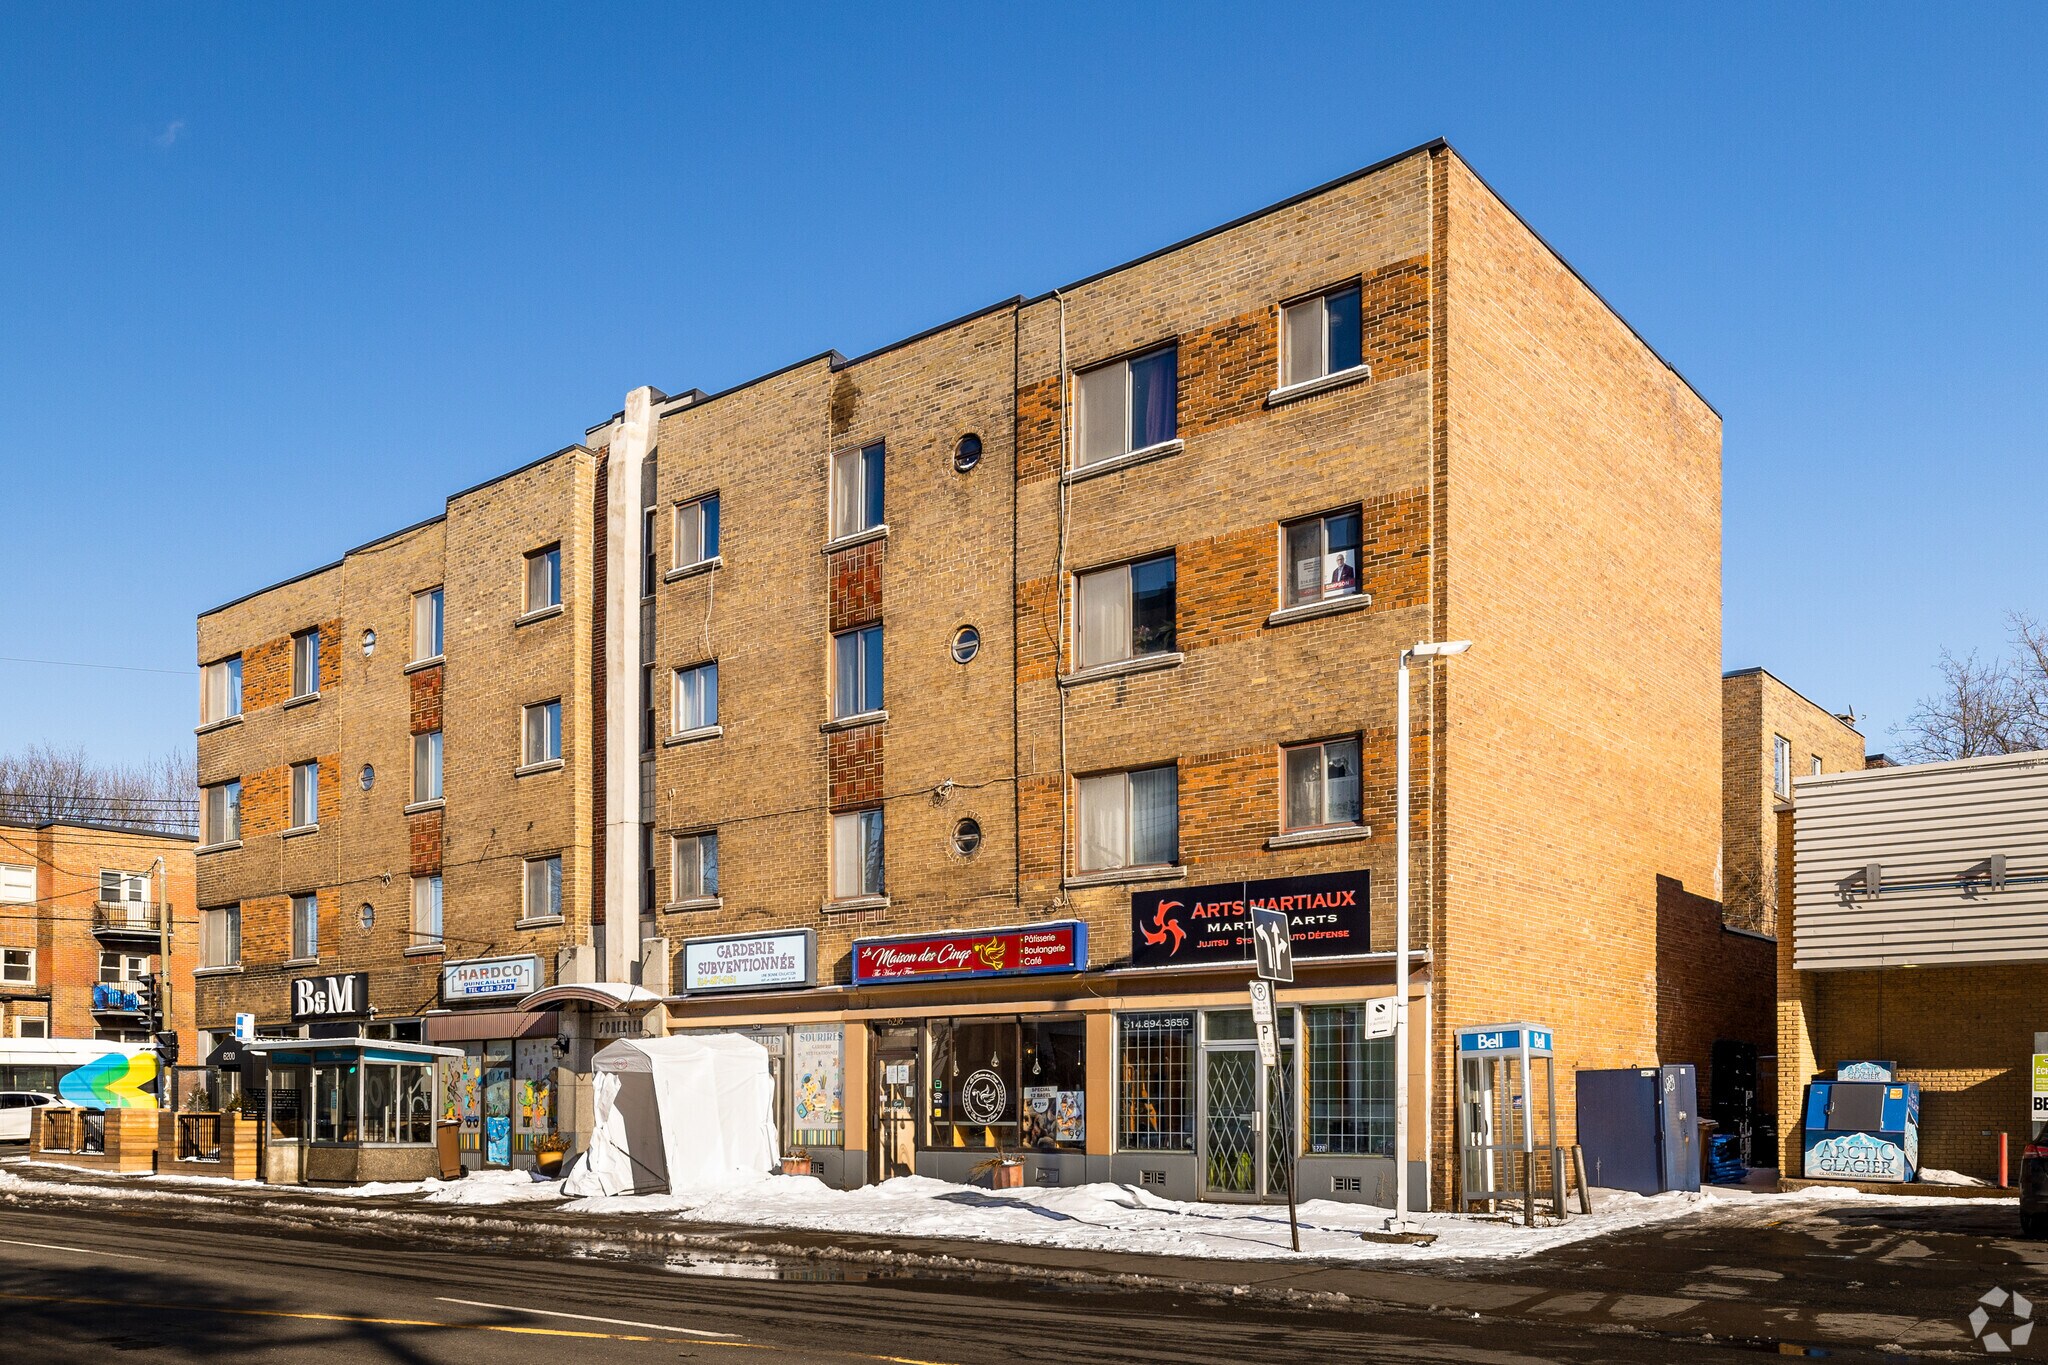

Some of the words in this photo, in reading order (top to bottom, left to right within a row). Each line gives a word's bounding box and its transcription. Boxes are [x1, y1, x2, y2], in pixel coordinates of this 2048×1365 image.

[1326, 582, 1350, 590] SIMPSON
[1191, 900, 1244, 920] ARTS
[1250, 890, 1356, 913] MARTIAUX
[1207, 921, 1254, 933] MART
[1291, 914, 1338, 926] ARTS
[1024, 933, 1056, 944] Pâtisserie
[1197, 939, 1229, 948] JUJITSU
[1289, 933, 1306, 941] UTO
[1307, 929, 1350, 940] DÉFENSE
[717, 941, 775, 959] GARDERIE
[871, 948, 917, 968] Maison
[918, 947, 937, 962] des
[937, 943, 972, 967] Cinqs
[1024, 943, 1066, 955] Boulangerie
[697, 953, 795, 975] SUBVENTIONNÉE
[1024, 955, 1042, 966] Café
[458, 964, 523, 980] HARDCO
[463, 978, 518, 987] QUINCAILLERIE
[295, 975, 356, 1016] B&M
[1124, 1018, 1189, 1029] 514.894.3656
[800, 1031, 843, 1042] SOURIRES
[1478, 1033, 1503, 1049] Bell
[1534, 1033, 1545, 1048] Bell
[223, 1051, 236, 1060] 6200
[1848, 1066, 1881, 1074] ARCTIC
[1820, 1141, 1895, 1160] ARCTIC
[1820, 1159, 1895, 1174] GLACIER
